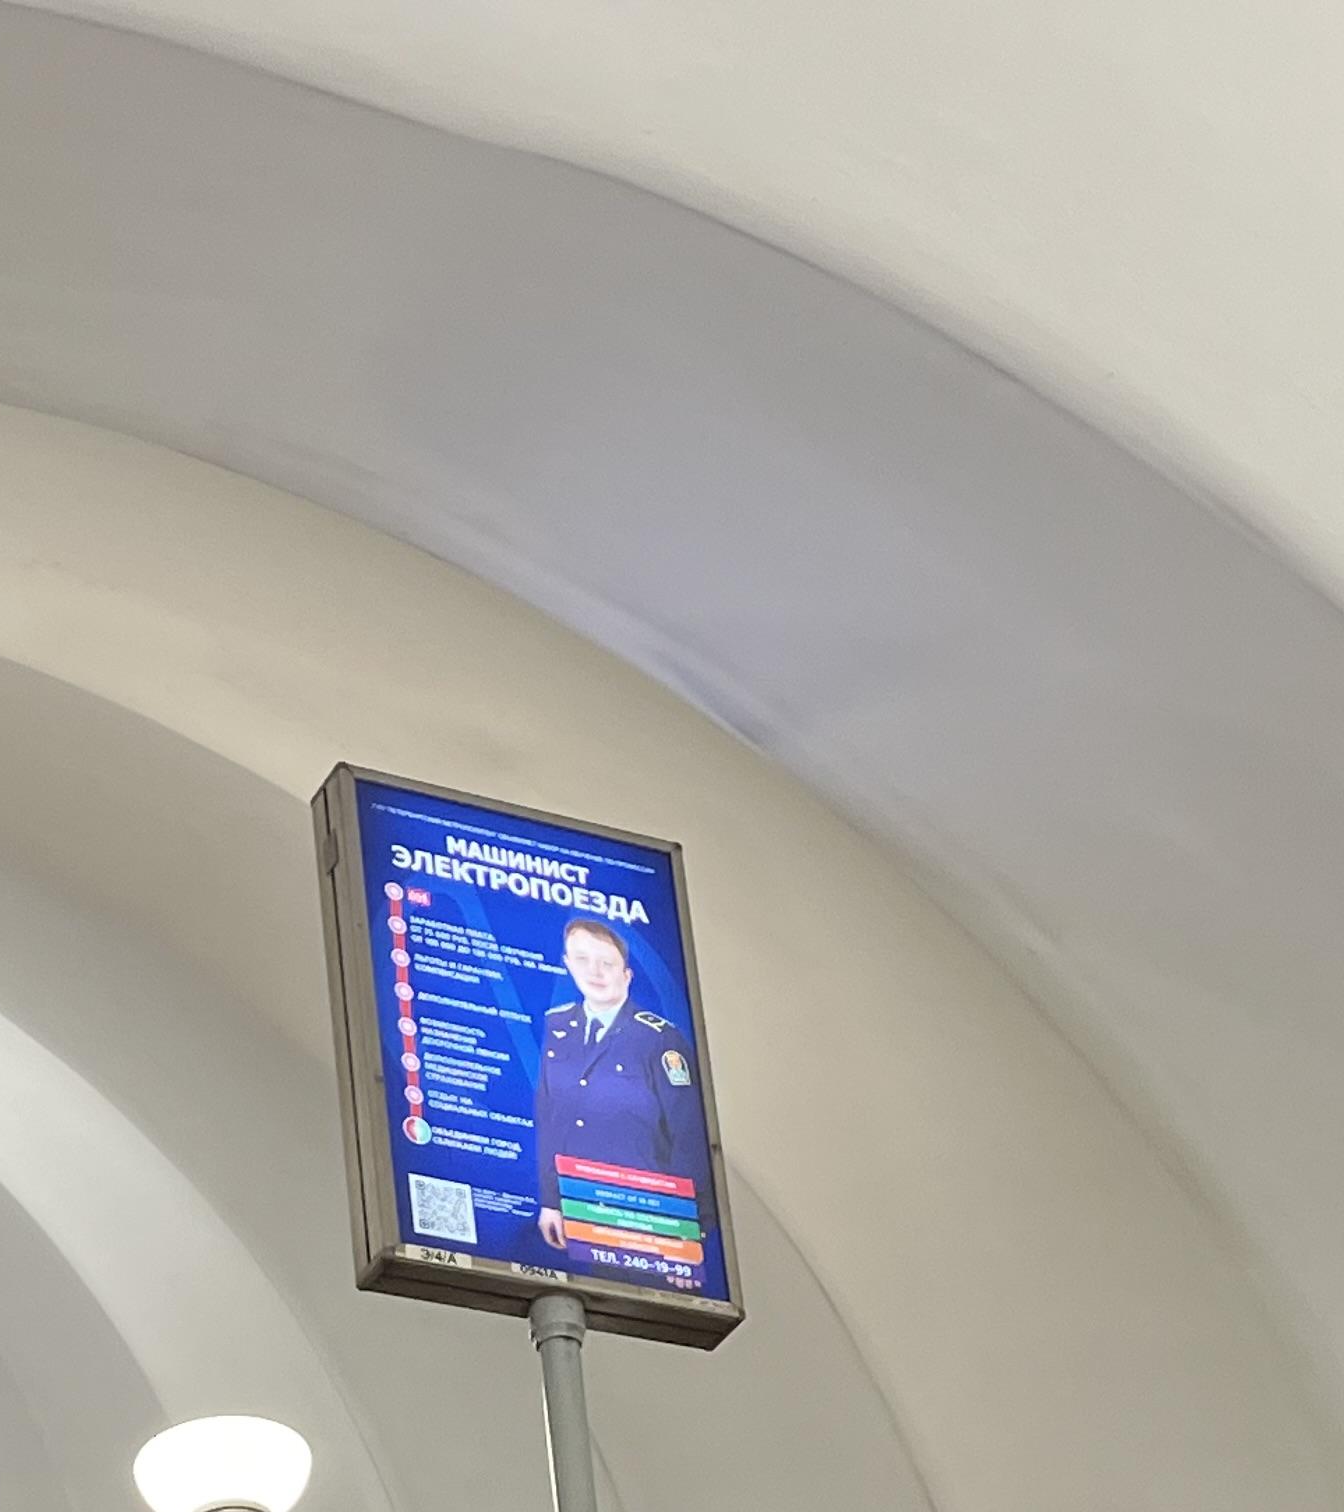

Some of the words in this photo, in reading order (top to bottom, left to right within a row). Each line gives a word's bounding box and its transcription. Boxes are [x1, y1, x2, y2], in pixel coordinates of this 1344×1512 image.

[391, 845, 650, 924] ЭЛЕКТРОПОЕЗДА
[446, 835, 589, 885] МАШИНИСТ
[590, 1248, 618, 1264] ТЕЛ.
[623, 1254, 692, 1278] 240-19-99
